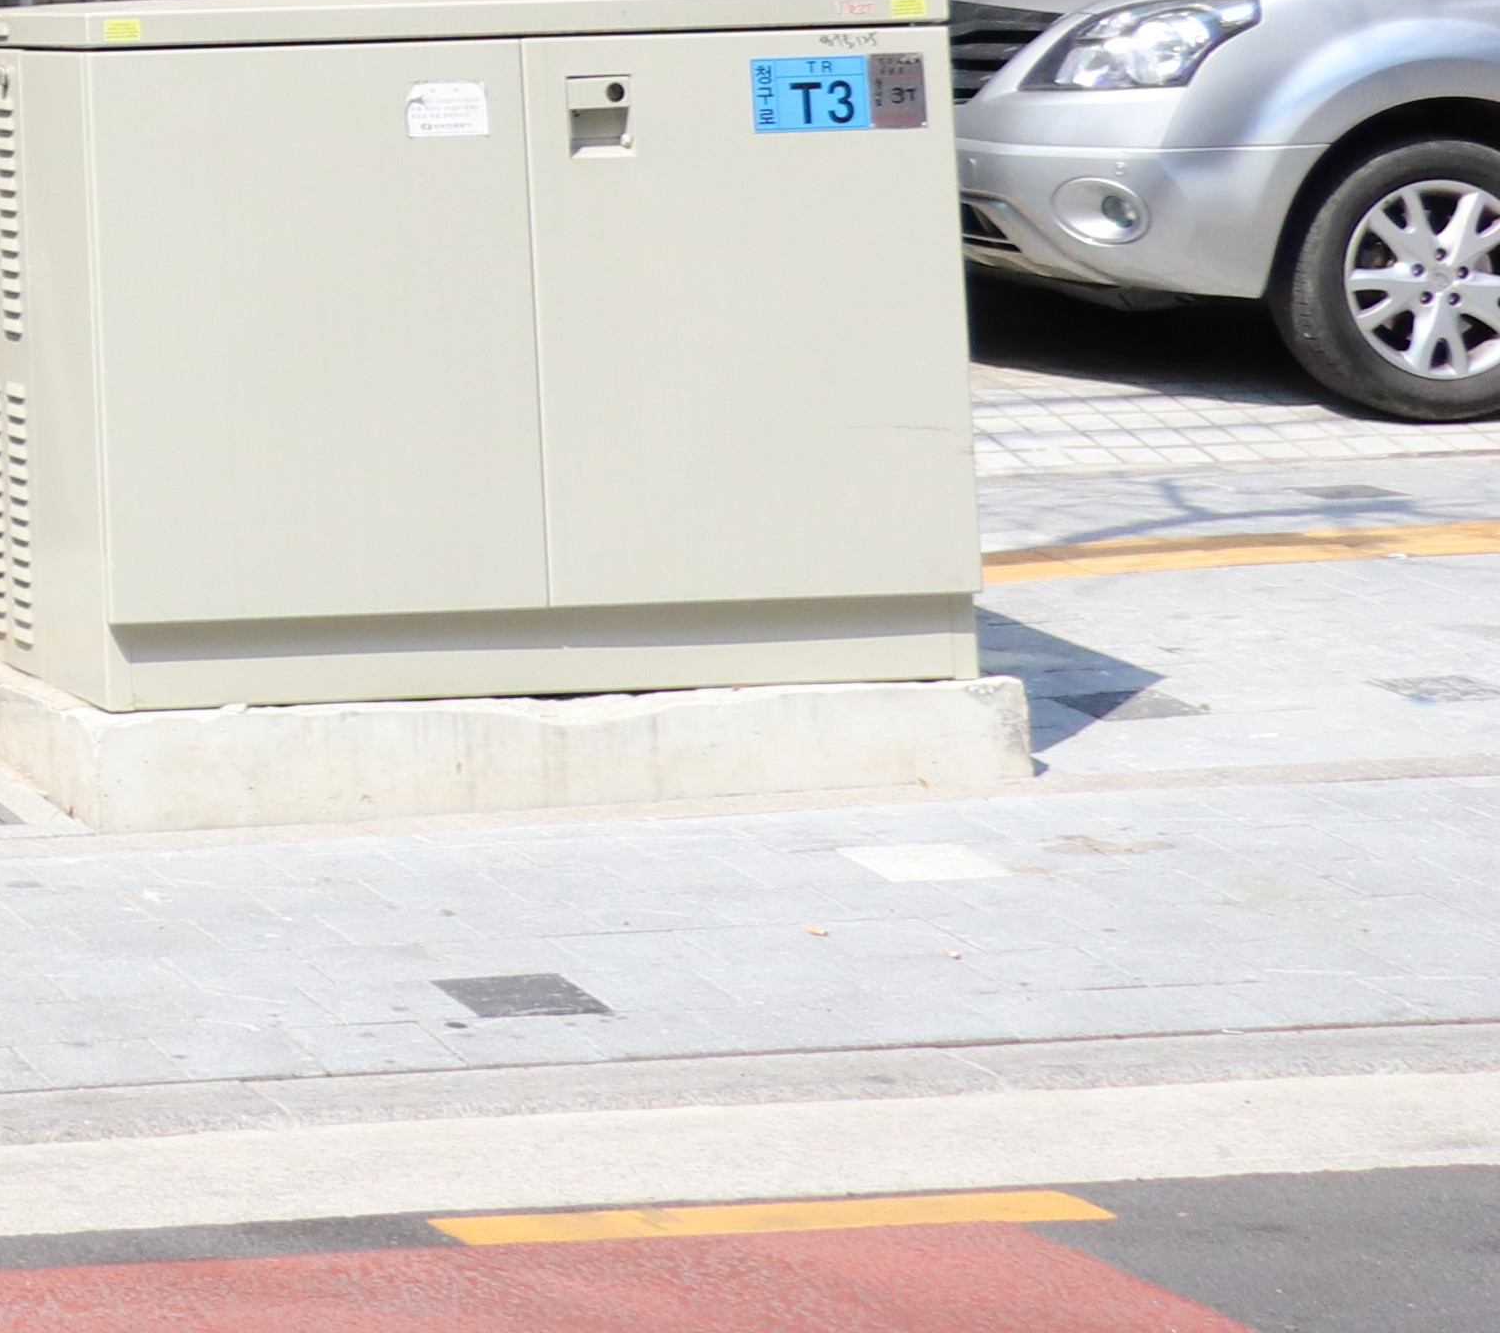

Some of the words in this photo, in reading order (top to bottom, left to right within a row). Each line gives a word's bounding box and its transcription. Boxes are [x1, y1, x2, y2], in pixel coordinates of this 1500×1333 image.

[806, 61, 833, 73] TR
[756, 64, 777, 126] 청구로
[789, 80, 855, 125] T3
